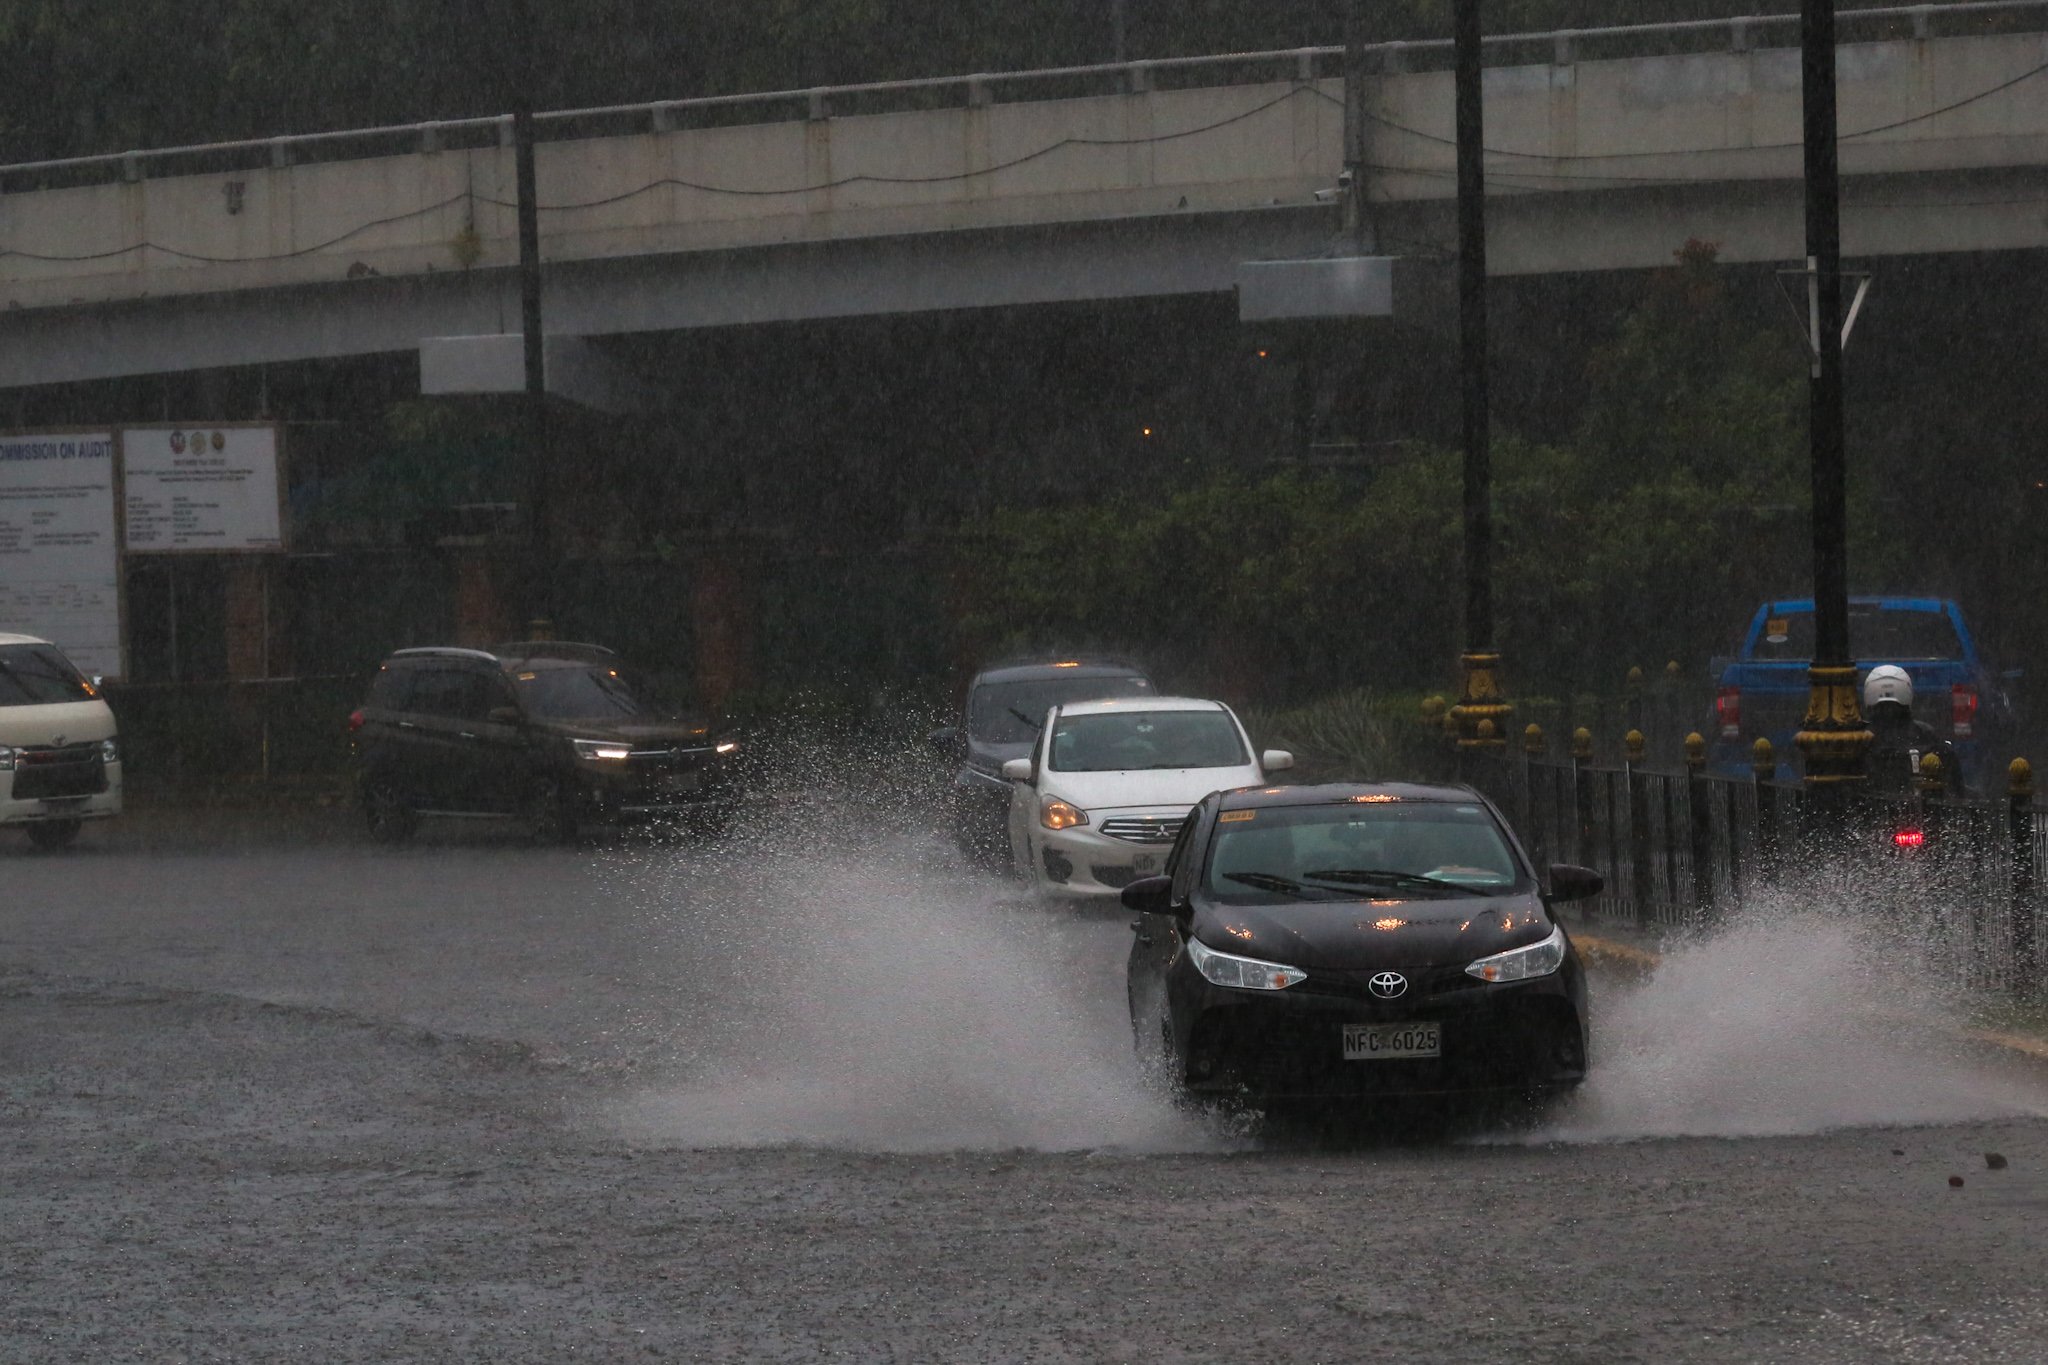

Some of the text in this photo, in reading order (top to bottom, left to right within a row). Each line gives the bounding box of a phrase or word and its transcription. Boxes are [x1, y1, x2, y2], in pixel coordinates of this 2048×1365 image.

[60, 442, 75, 459] ON
[79, 440, 112, 458] AUDIT
[1345, 1031, 1437, 1052] NFC 6025
